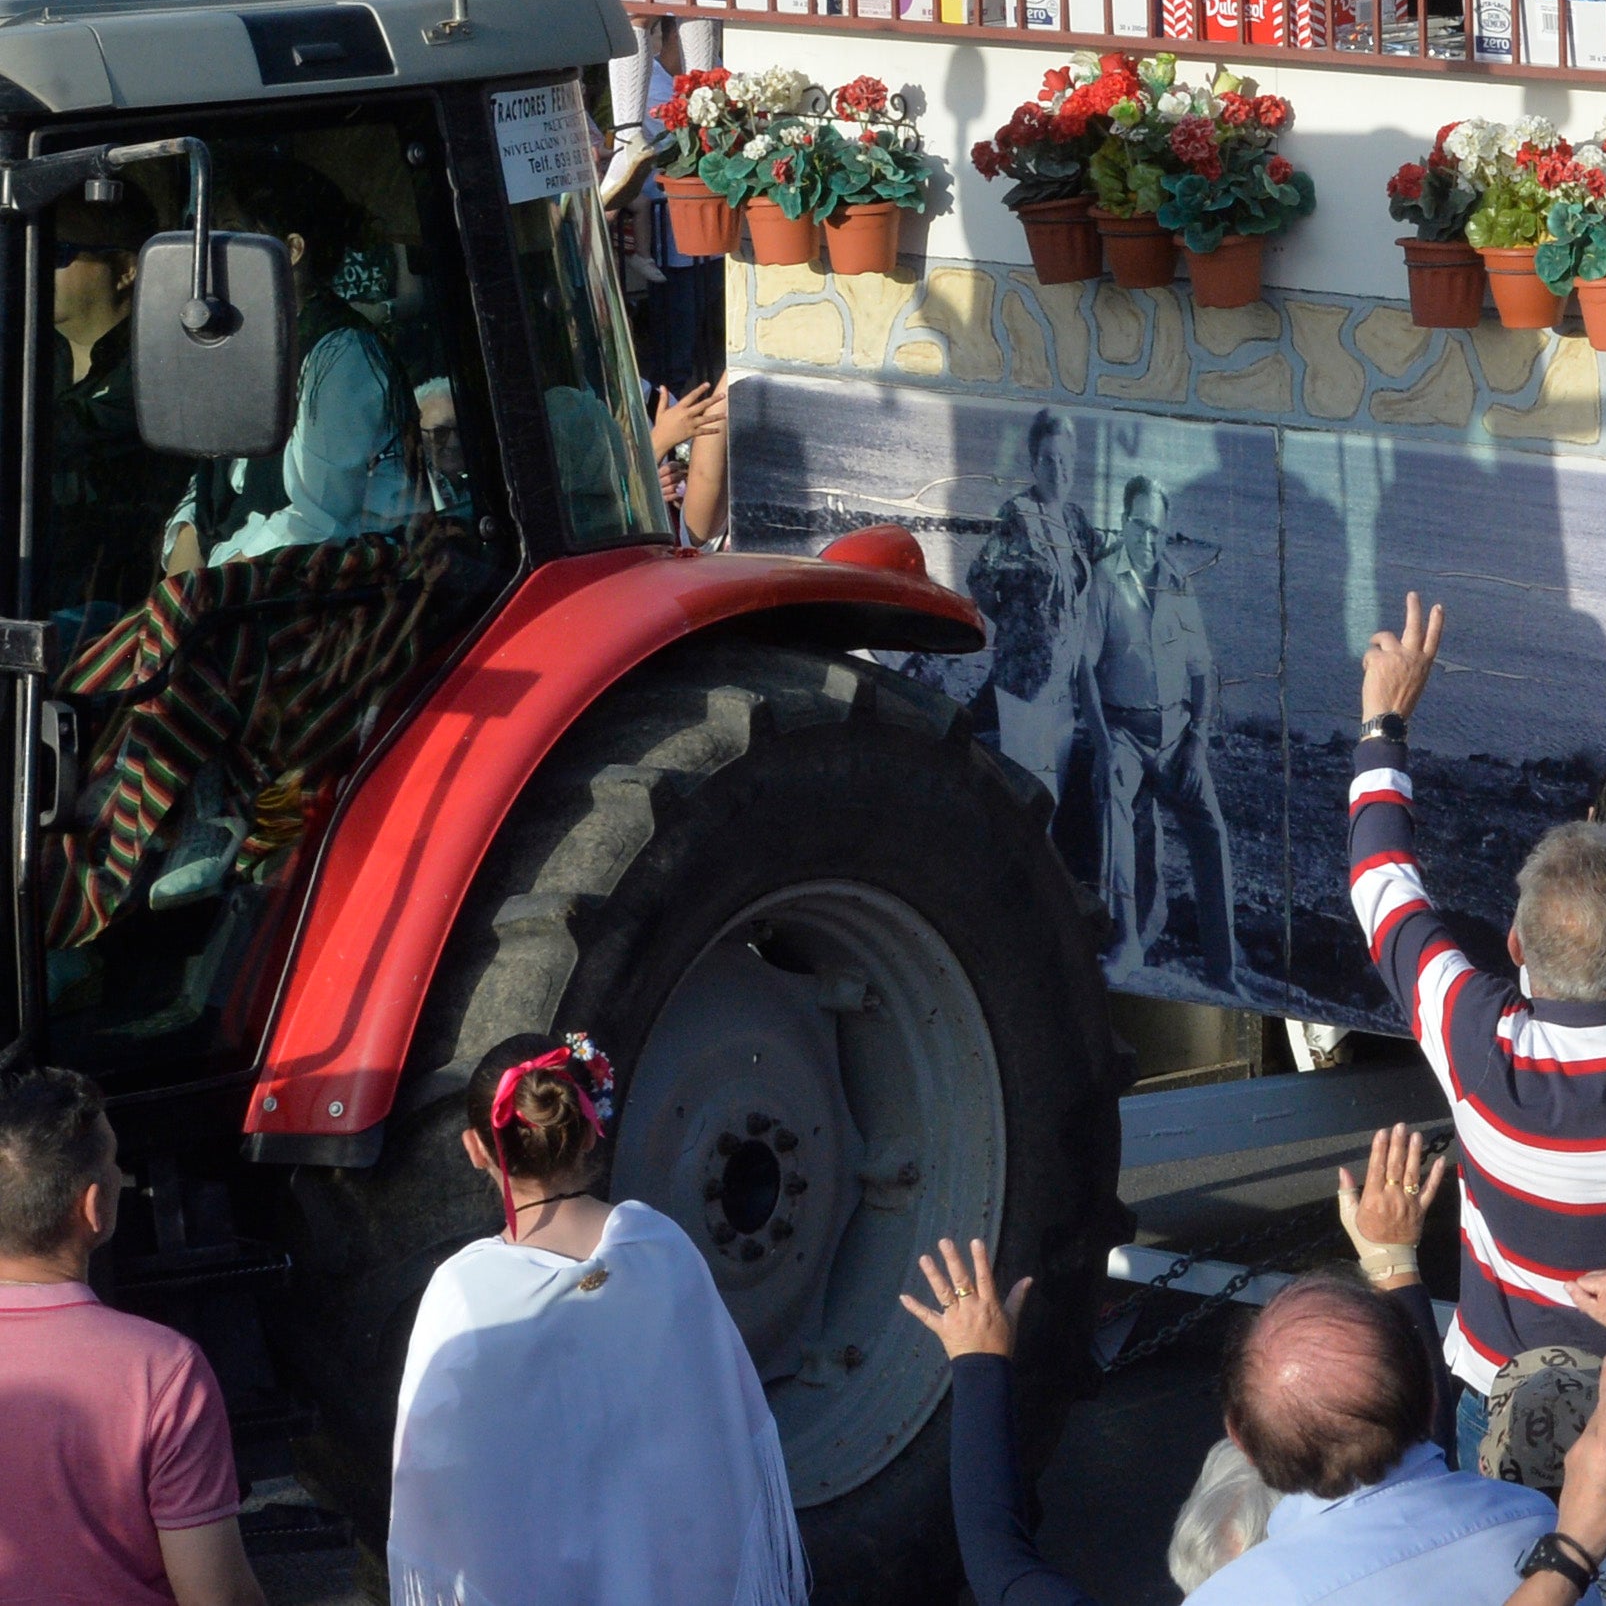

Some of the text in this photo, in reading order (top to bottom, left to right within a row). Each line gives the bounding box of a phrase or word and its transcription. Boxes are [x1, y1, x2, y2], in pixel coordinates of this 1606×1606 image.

[1026, 8, 1046, 20] ero
[1482, 37, 1510, 50] zero
[490, 94, 546, 123] TRACTORES
[528, 154, 552, 174] Telf.
